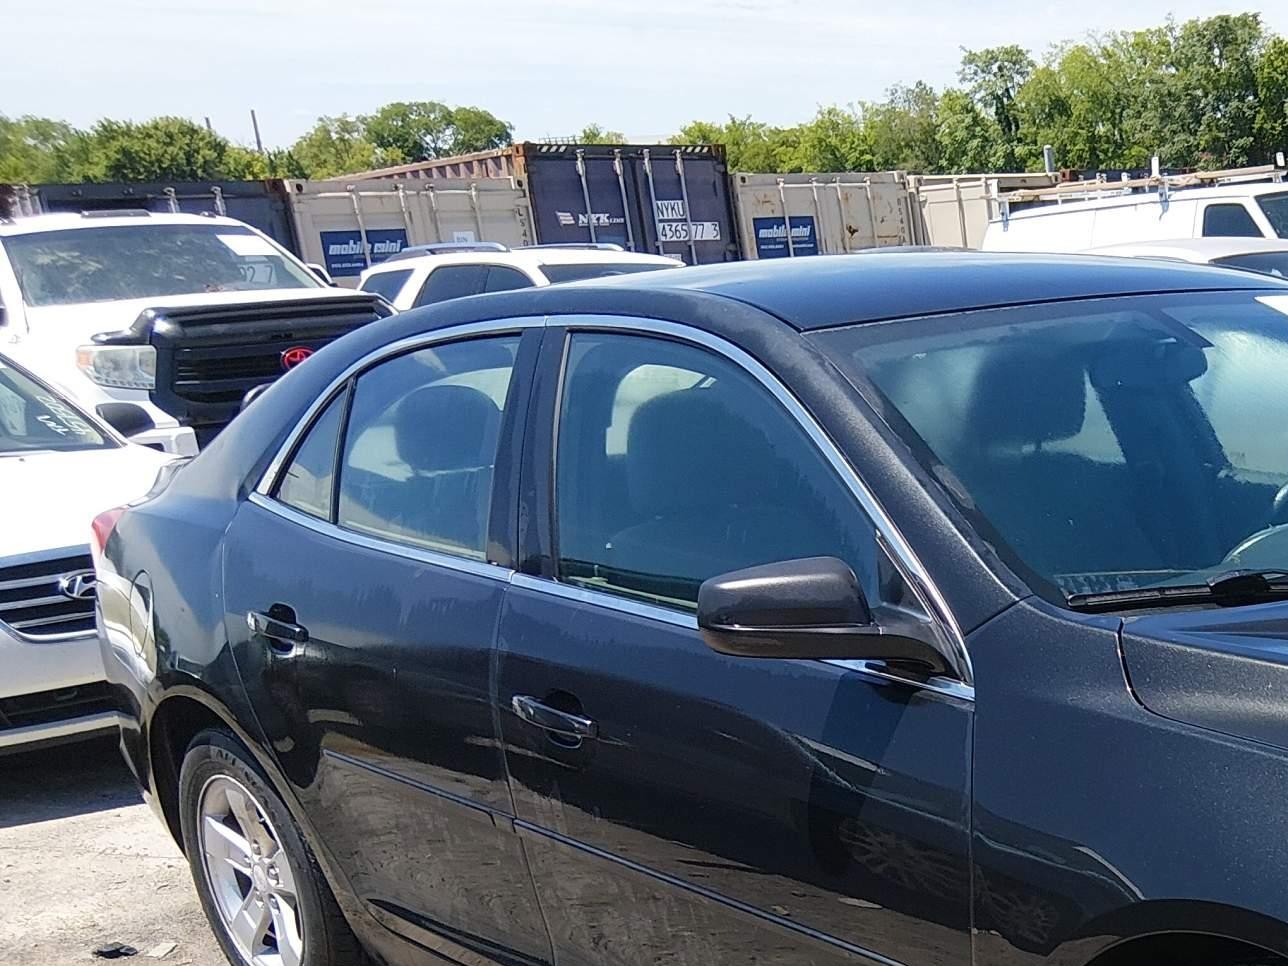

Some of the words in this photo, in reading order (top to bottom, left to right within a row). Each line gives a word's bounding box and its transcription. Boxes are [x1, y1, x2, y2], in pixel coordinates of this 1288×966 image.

[656, 201, 686, 218] NYKU
[578, 213, 609, 226] NYK
[711, 223, 719, 239] 3
[791, 225, 811, 237] mini
[373, 239, 402, 254] mini
